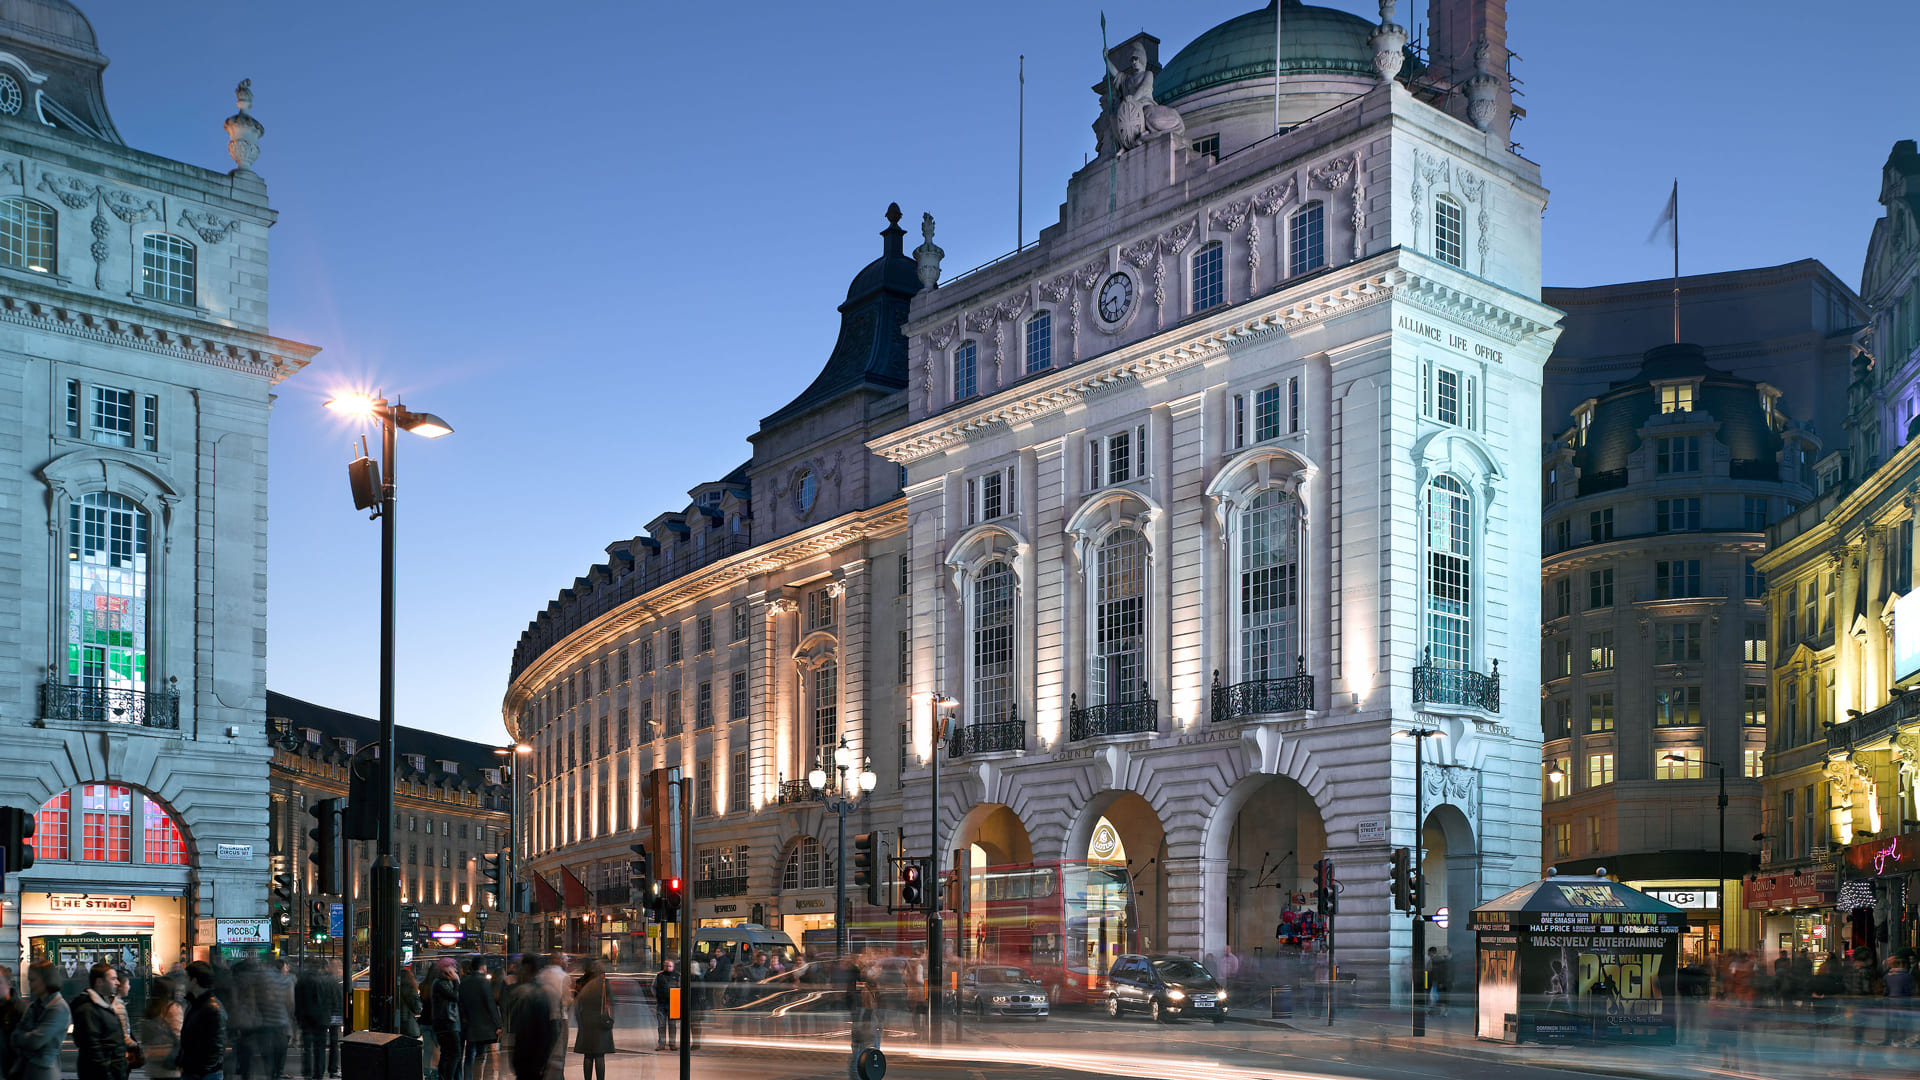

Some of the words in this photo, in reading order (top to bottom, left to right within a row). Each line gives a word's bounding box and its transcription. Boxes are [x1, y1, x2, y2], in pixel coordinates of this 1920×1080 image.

[1399, 315, 1441, 342] ALLIANCE
[1449, 334, 1467, 351] LIFE
[1475, 344, 1503, 364] OFFICE
[1414, 713, 1441, 724] COUNTY
[1096, 840, 1113, 850] LOTUS
[1789, 875, 1815, 888] DONUTS
[54, 899, 81, 908] THE
[86, 901, 127, 909] STING
[1668, 893, 1695, 905] UGG
[1591, 913, 1602, 924] WE
[1603, 913, 1620, 924] WILL
[1622, 913, 1641, 924] ROCK
[1643, 913, 1657, 924] YOU
[1601, 954, 1616, 964] WE
[1619, 954, 1642, 964] WILL
